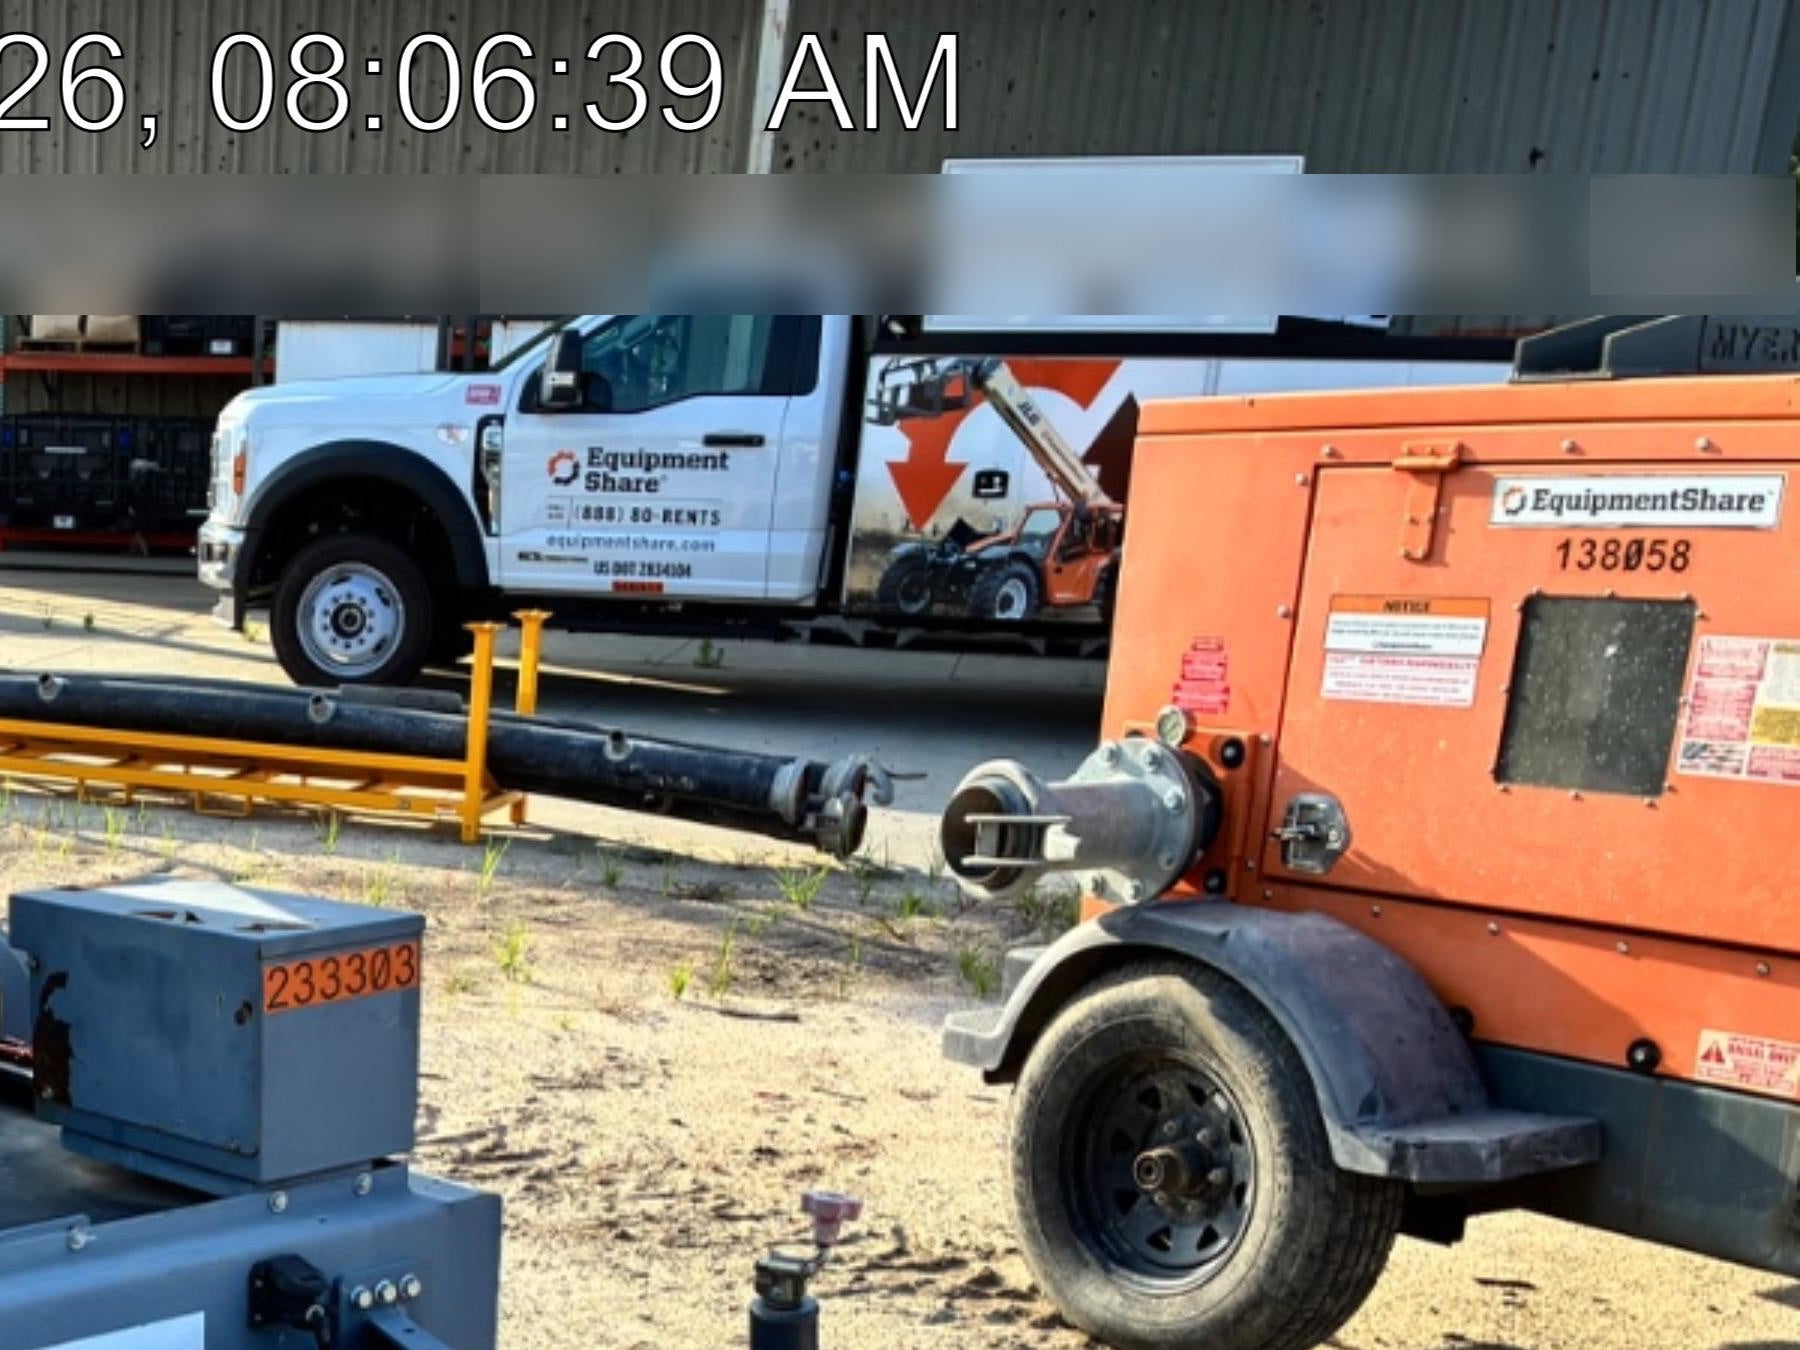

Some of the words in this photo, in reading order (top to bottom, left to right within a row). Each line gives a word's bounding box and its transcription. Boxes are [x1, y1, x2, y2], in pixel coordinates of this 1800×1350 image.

[587, 447, 730, 473] Equipment
[585, 471, 660, 493] Share
[574, 504, 624, 523] (888)
[629, 506, 721, 526] 80-RENTS
[1531, 488, 1765, 516] EquipmentShare
[546, 534, 716, 552] equipmentshare.com
[1555, 538, 1691, 572] 138058
[266, 944, 415, 1010] 233303
